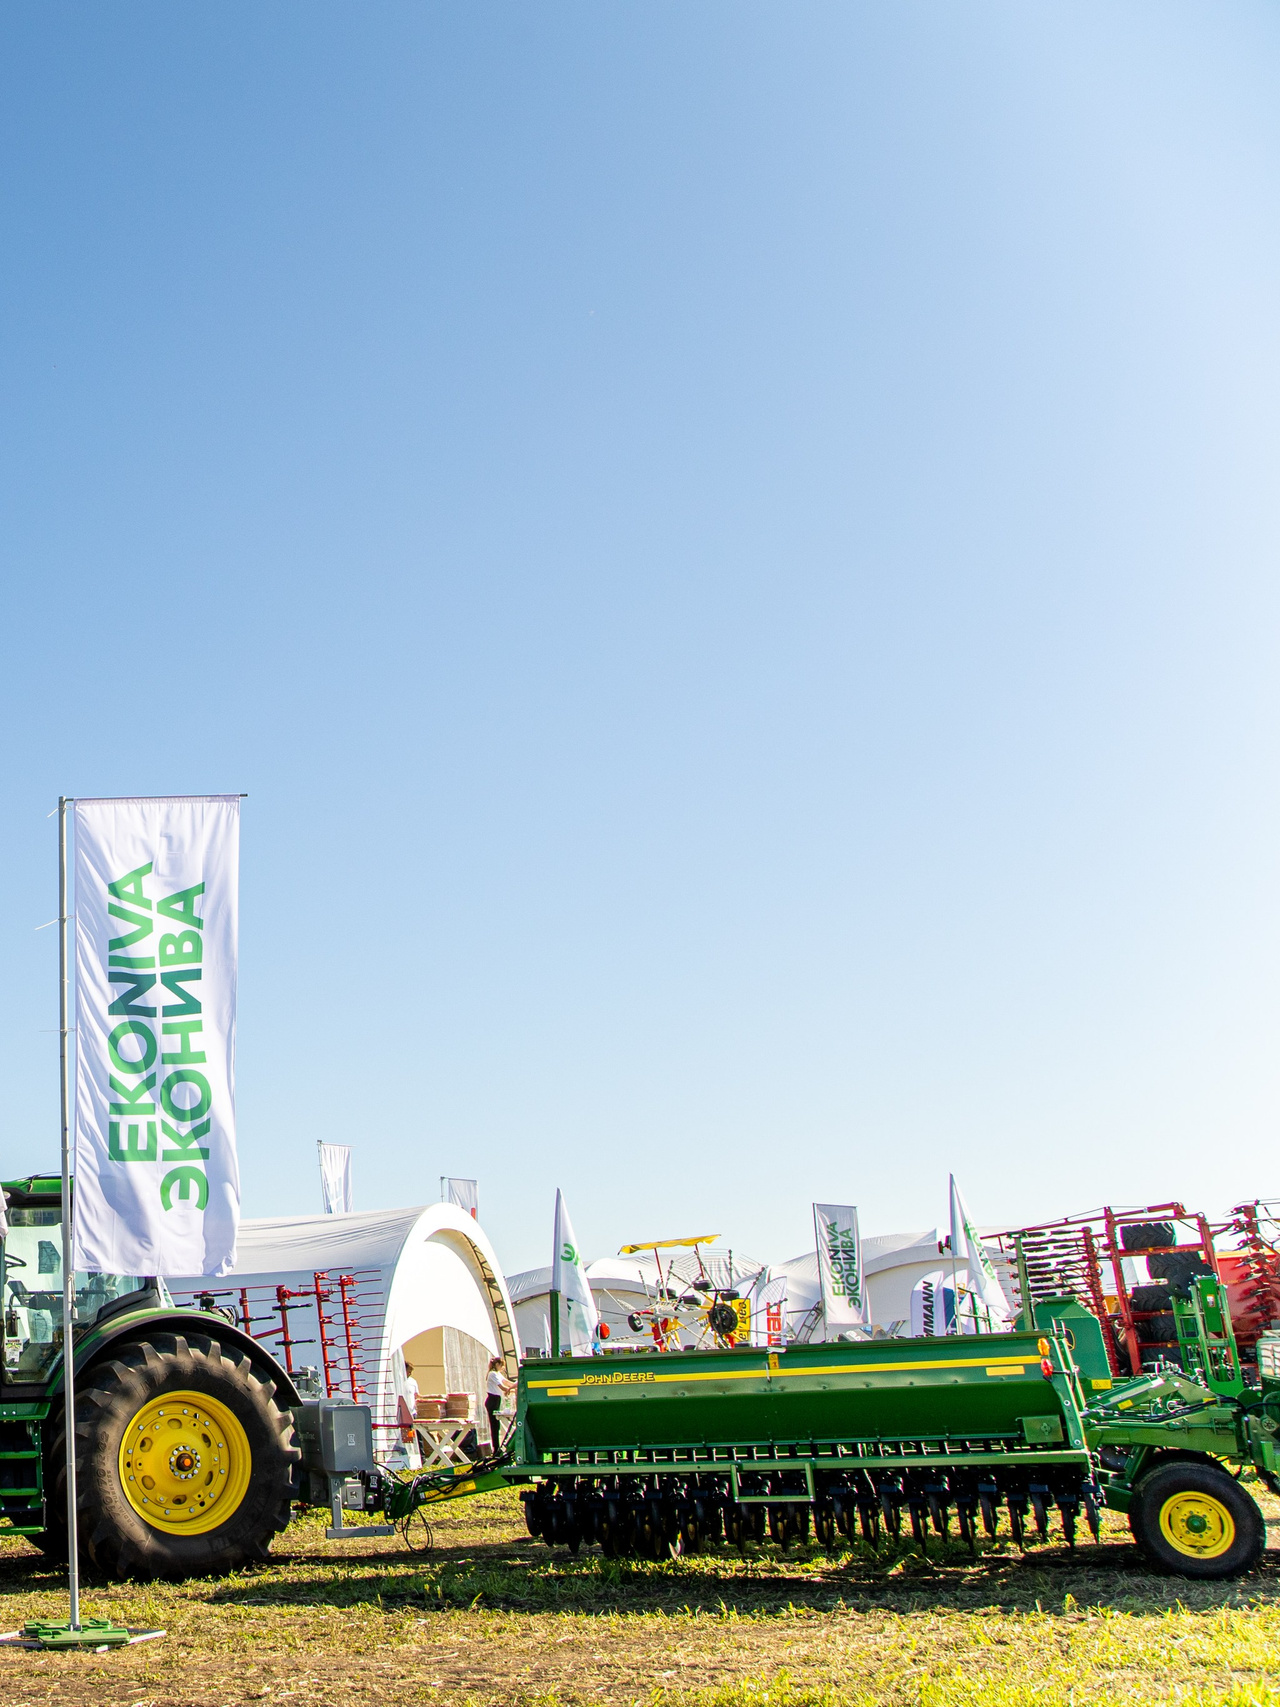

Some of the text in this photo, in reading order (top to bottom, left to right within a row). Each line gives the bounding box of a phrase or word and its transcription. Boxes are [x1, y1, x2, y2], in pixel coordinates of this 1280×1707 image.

[108, 861, 157, 1162] EKONIVA
[157, 881, 212, 1212] ЭКОНИВА
[826, 1221, 846, 1297] EKONIVA
[838, 1227, 862, 1308] ЭКОНИВА
[580, 1371, 655, 1385] JOHN DEERE
